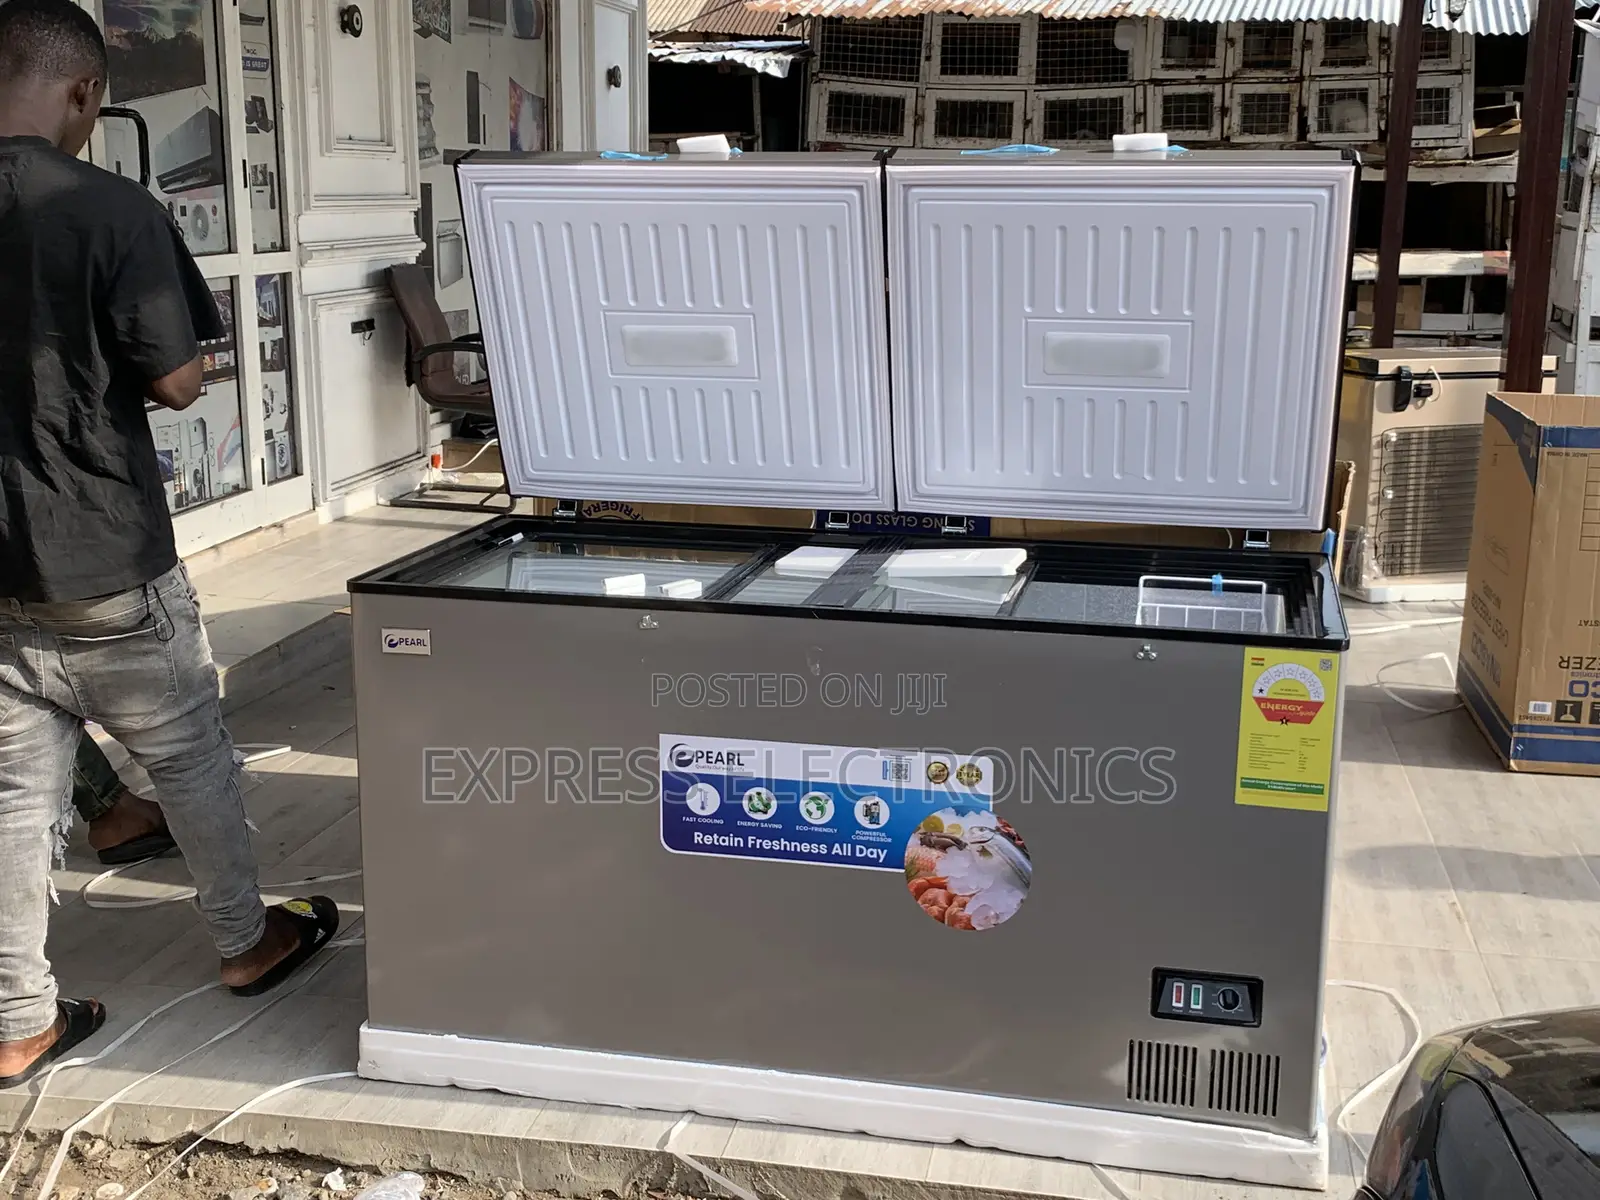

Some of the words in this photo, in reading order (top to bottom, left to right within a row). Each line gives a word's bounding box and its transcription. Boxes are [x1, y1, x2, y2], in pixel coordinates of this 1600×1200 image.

[876, 514, 918, 527] GLASS
[398, 637, 427, 646] PEARL
[695, 750, 744, 766] PEARL
[796, 825, 838, 833] ECO-FRIENDLY
[851, 835, 892, 843] COMPRESSOR
[693, 831, 744, 848] Retain
[747, 836, 828, 854] Freshness
[832, 843, 851, 856] All
[856, 845, 888, 863] Day
